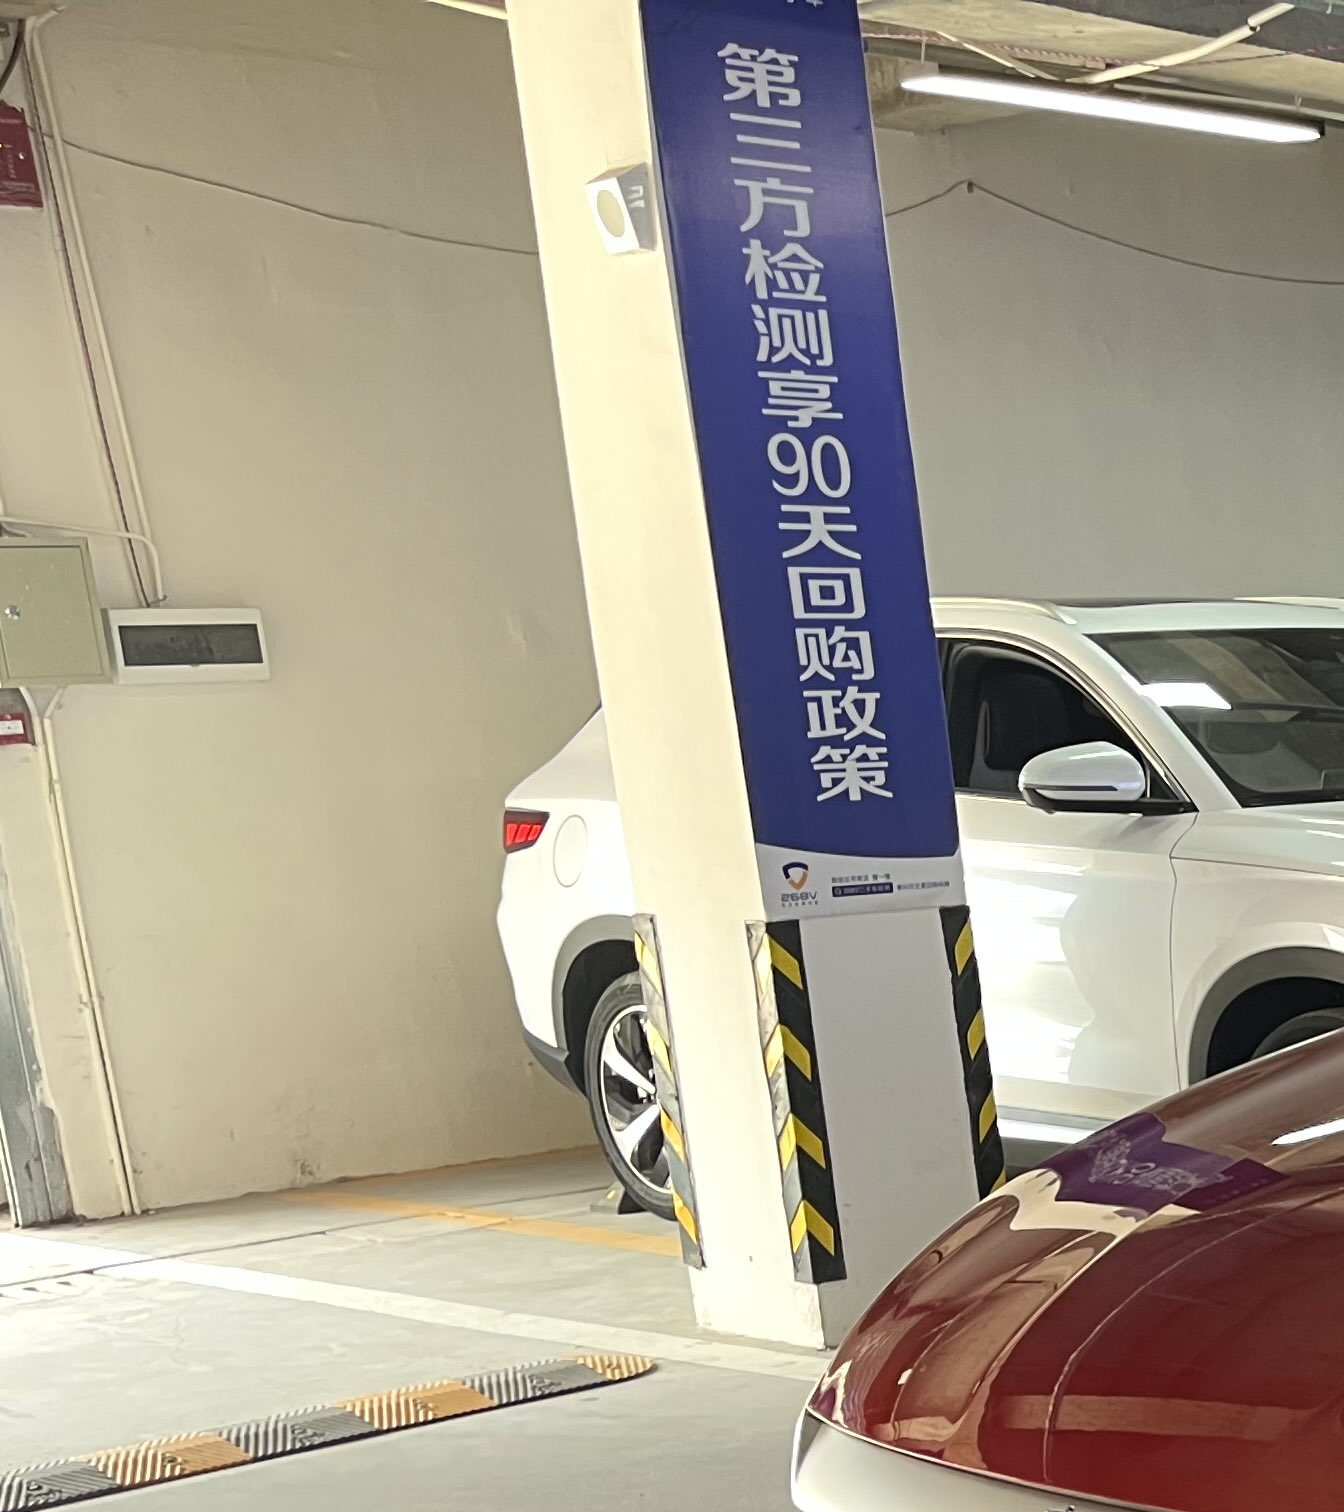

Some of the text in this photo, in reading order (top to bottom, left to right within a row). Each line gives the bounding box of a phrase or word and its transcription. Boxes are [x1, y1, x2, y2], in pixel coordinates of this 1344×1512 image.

[717, 42, 894, 802] 第三方检测享90天回购政策
